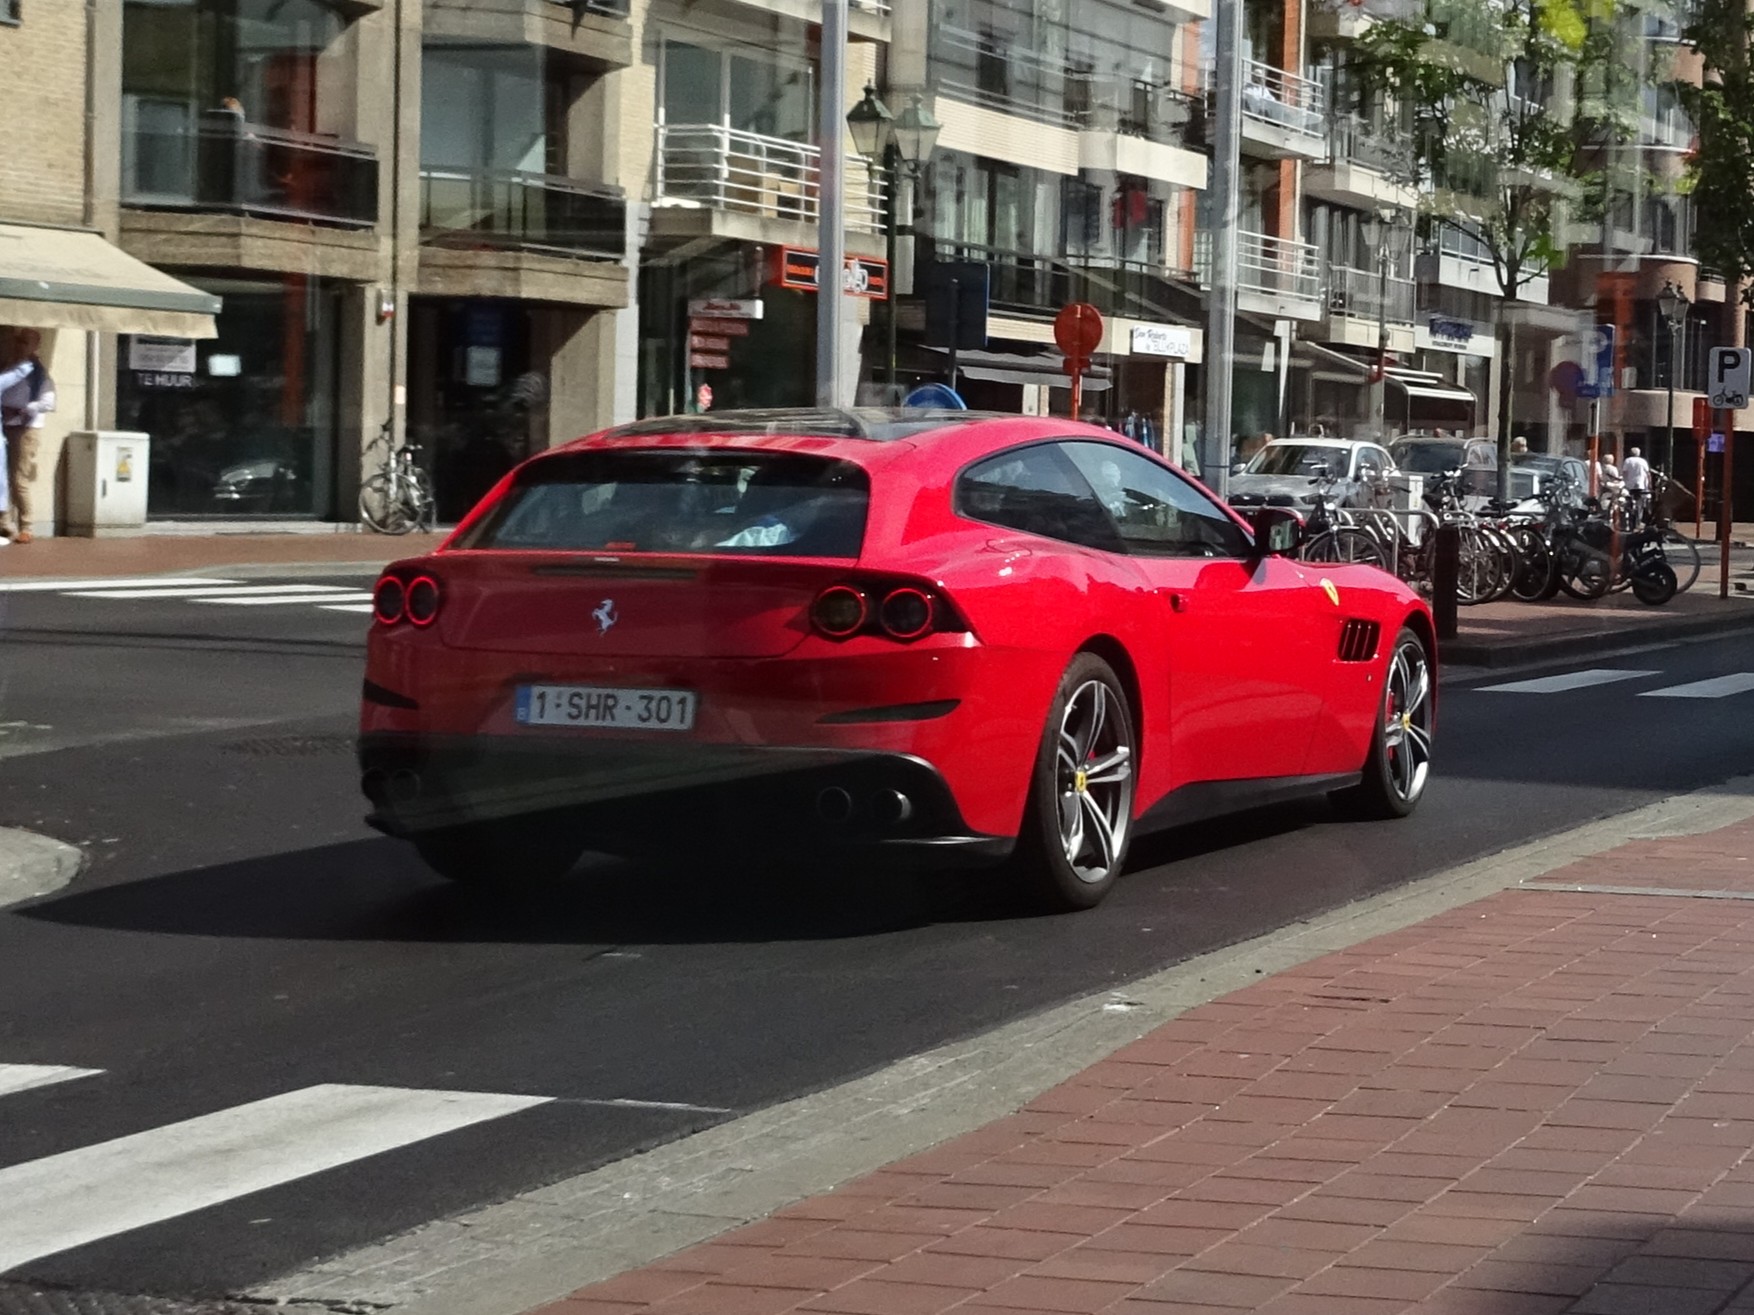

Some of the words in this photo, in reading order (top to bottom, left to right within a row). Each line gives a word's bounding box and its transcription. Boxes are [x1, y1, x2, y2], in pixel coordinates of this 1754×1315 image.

[1718, 350, 1741, 383] P
[138, 373, 154, 386] TE
[155, 374, 194, 387] HUUR
